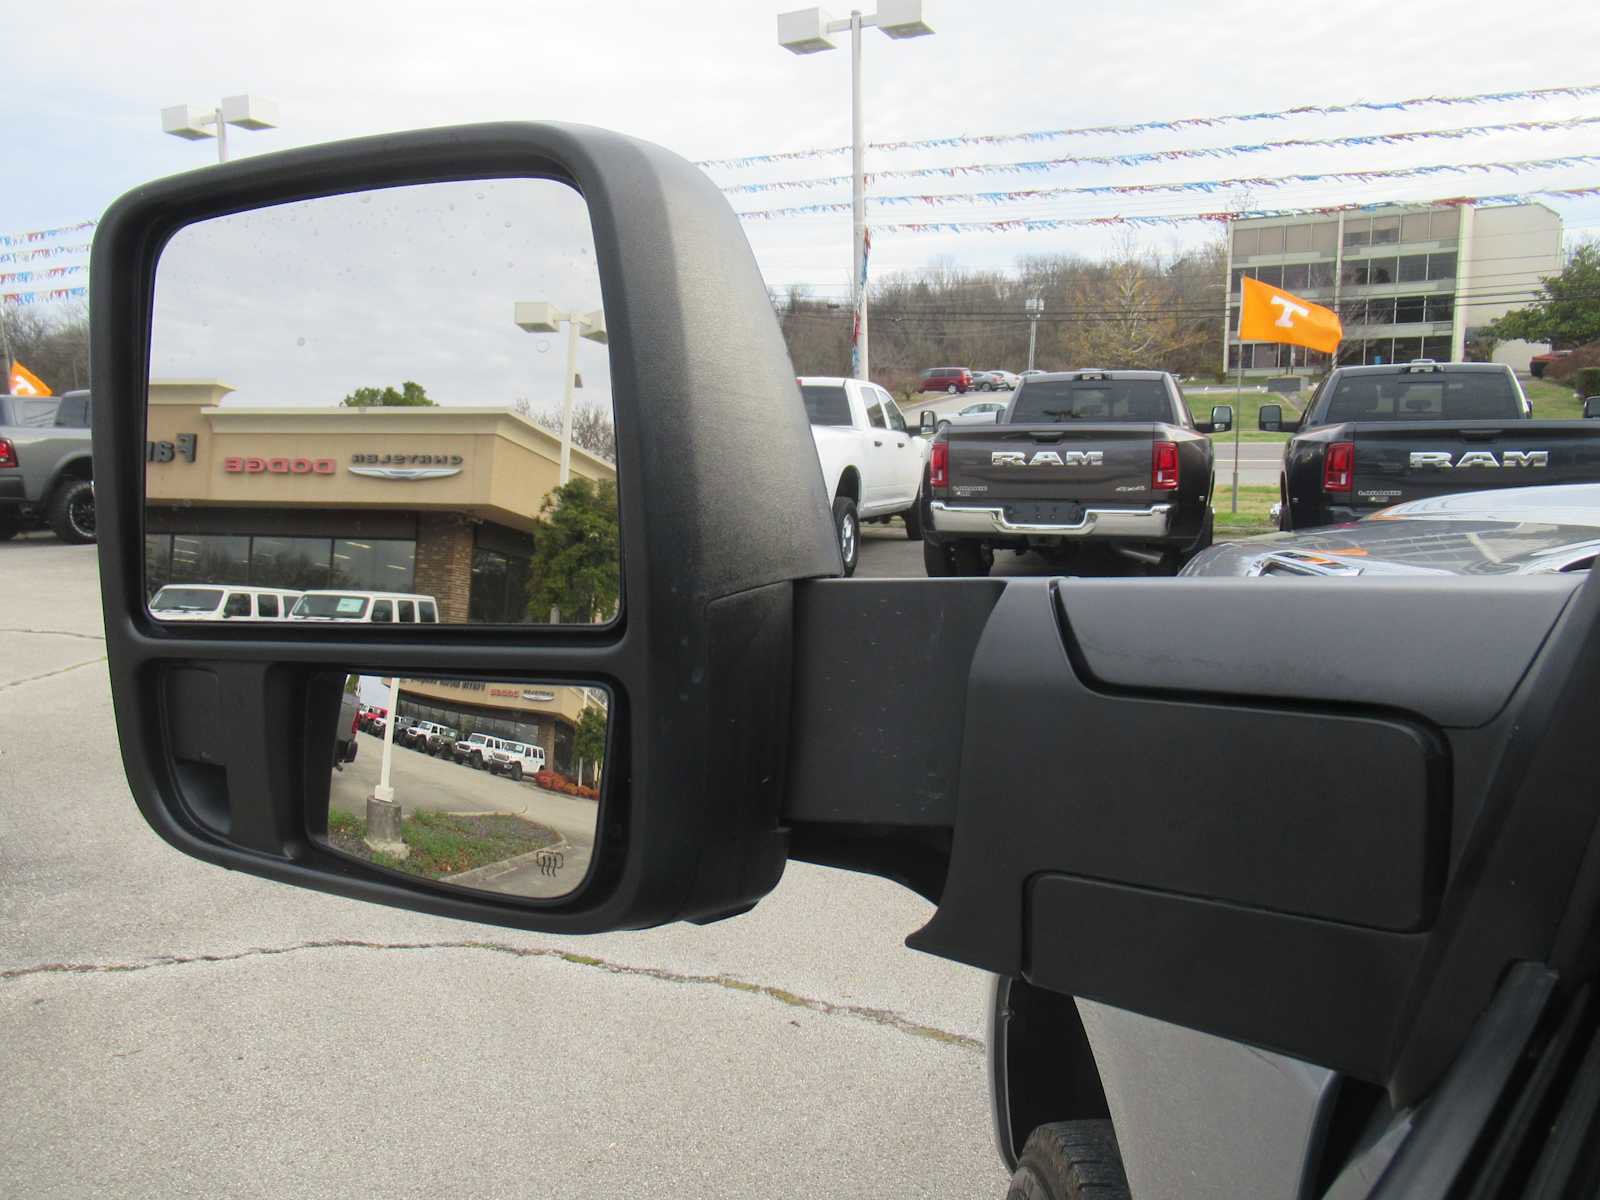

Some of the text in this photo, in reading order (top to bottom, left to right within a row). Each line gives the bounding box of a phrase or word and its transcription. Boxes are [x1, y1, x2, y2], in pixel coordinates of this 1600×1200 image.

[1271, 296, 1309, 327] T
[991, 451, 1104, 466] RAM
[1409, 451, 1549, 468] RAM
